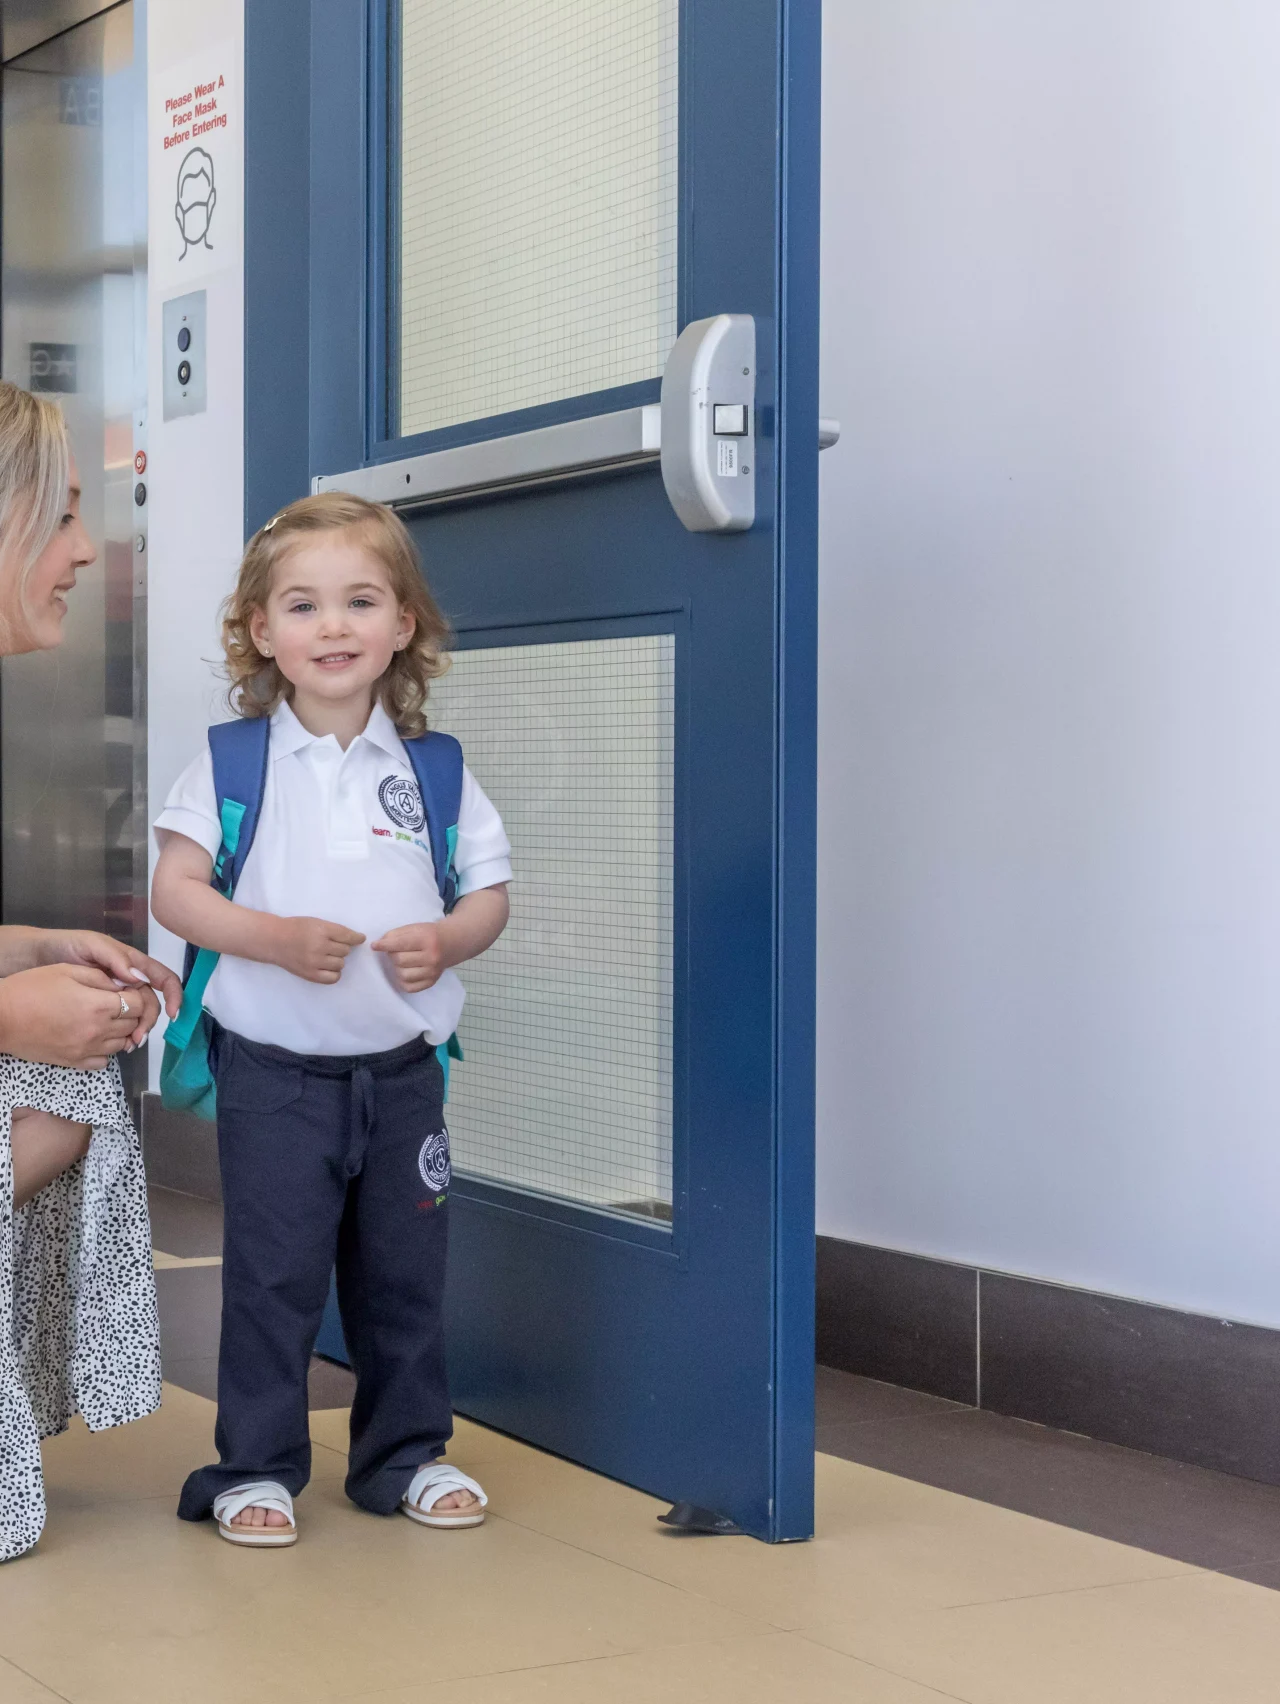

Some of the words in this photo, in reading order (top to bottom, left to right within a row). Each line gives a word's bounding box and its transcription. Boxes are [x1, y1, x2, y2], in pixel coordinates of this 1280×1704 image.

[165, 92, 192, 113] Please
[194, 80, 216, 99] Wear
[218, 74, 224, 89] A
[172, 110, 192, 128] Face
[194, 97, 217, 118] Mask
[163, 130, 190, 150] Before
[192, 113, 227, 137] Entering
